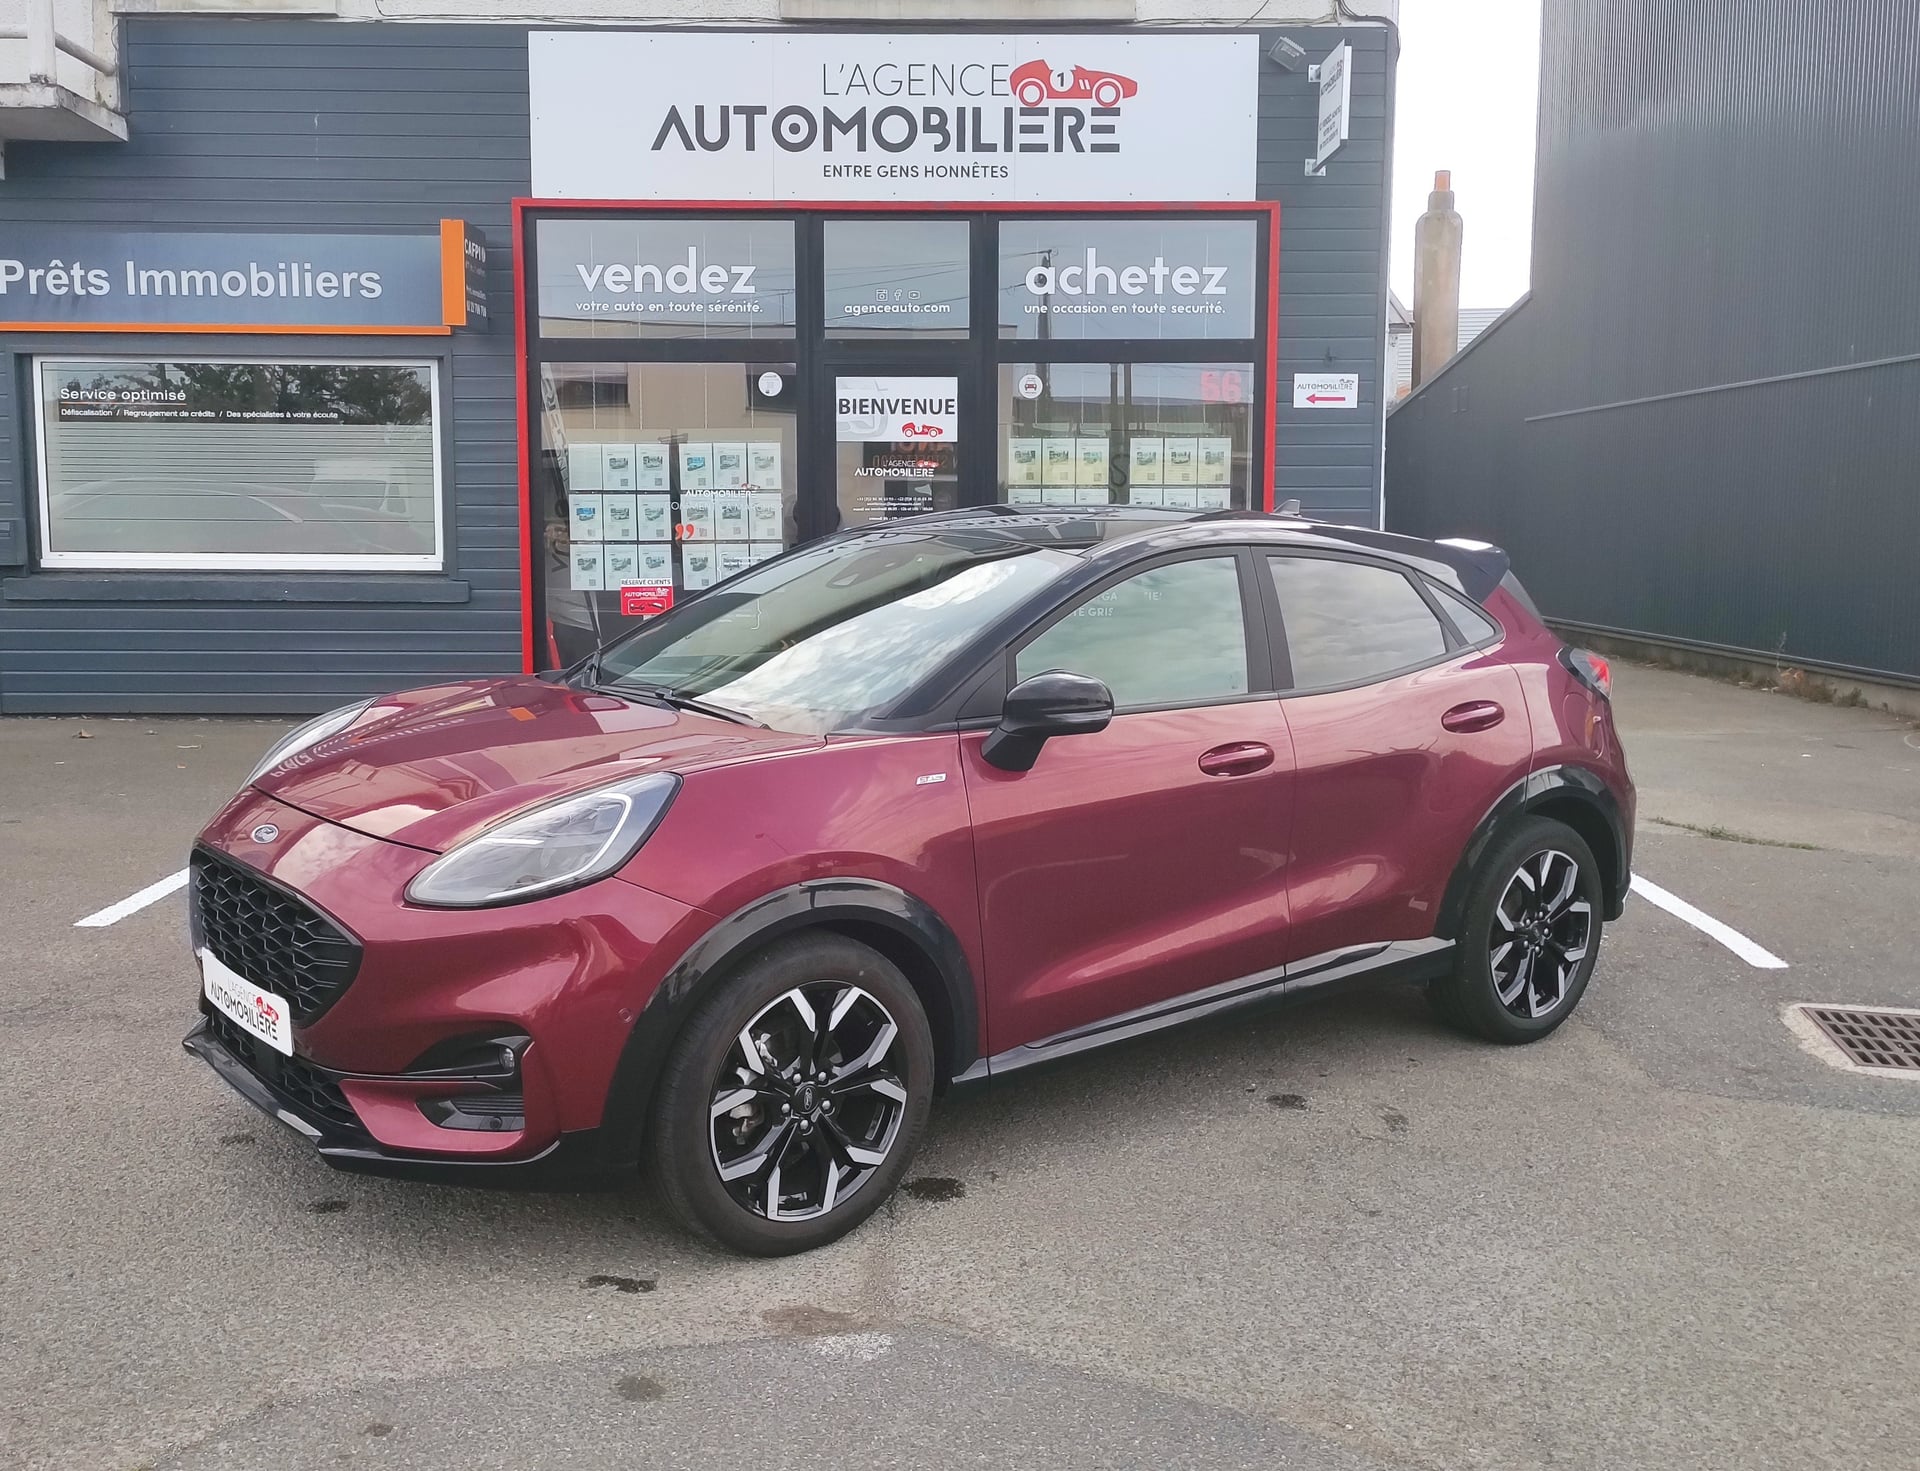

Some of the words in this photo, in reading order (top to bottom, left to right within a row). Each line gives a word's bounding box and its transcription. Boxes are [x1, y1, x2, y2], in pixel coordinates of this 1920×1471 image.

[823, 164, 873, 178] ENTRE
[876, 165, 919, 179] GENS
[923, 161, 1009, 179] HONNÊTES
[575, 246, 757, 295] vendez
[1025, 247, 1228, 296] achetez
[0, 259, 111, 296] Prêts
[126, 260, 383, 300] Immobiliers
[575, 301, 610, 313] votre
[614, 301, 644, 313] auto
[648, 303, 665, 313] en
[668, 302, 704, 313] toute
[708, 300, 763, 313] sérénité.
[844, 302, 951, 316] agenceauto.com
[1024, 304, 1048, 314] une
[1052, 301, 1107, 314] occasion
[1111, 304, 1127, 314] en
[1131, 303, 1167, 314] toute
[1171, 300, 1226, 314] securité.
[60, 387, 116, 400] Service
[121, 389, 187, 402] optimisé
[61, 408, 113, 416] Défiscalisation
[123, 409, 178, 418] Regroupement
[179, 409, 189, 417] de
[190, 410, 216, 418] crédits
[242, 411, 285, 419] spécialistes
[838, 398, 956, 415] BIENVENUE
